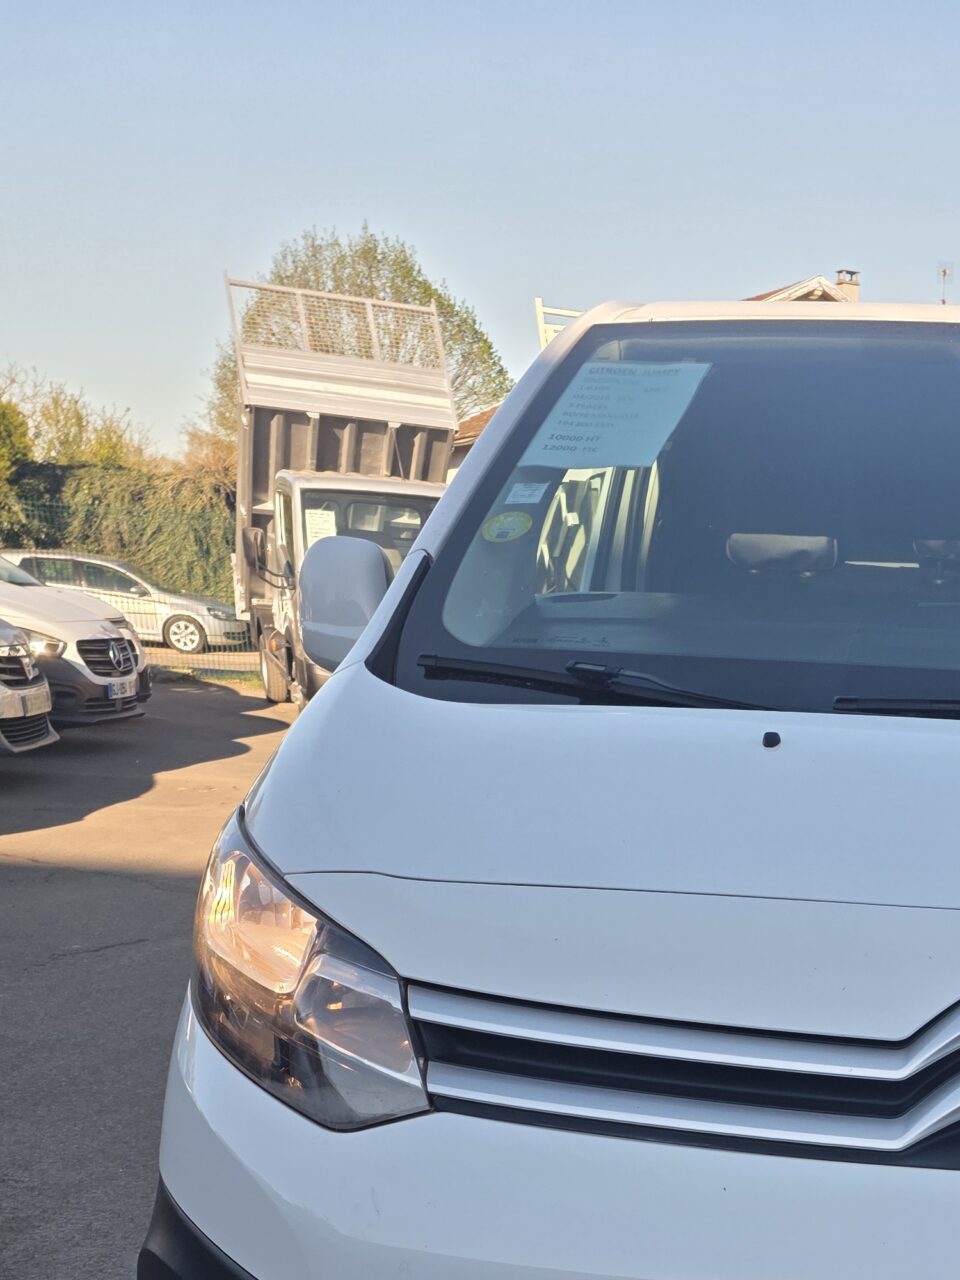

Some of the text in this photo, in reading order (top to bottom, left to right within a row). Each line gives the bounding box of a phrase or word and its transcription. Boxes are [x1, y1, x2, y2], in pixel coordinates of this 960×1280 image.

[588, 367, 682, 377] CITROEN JUMPY
[549, 433, 583, 442] 10000
[542, 444, 578, 452] 12000
